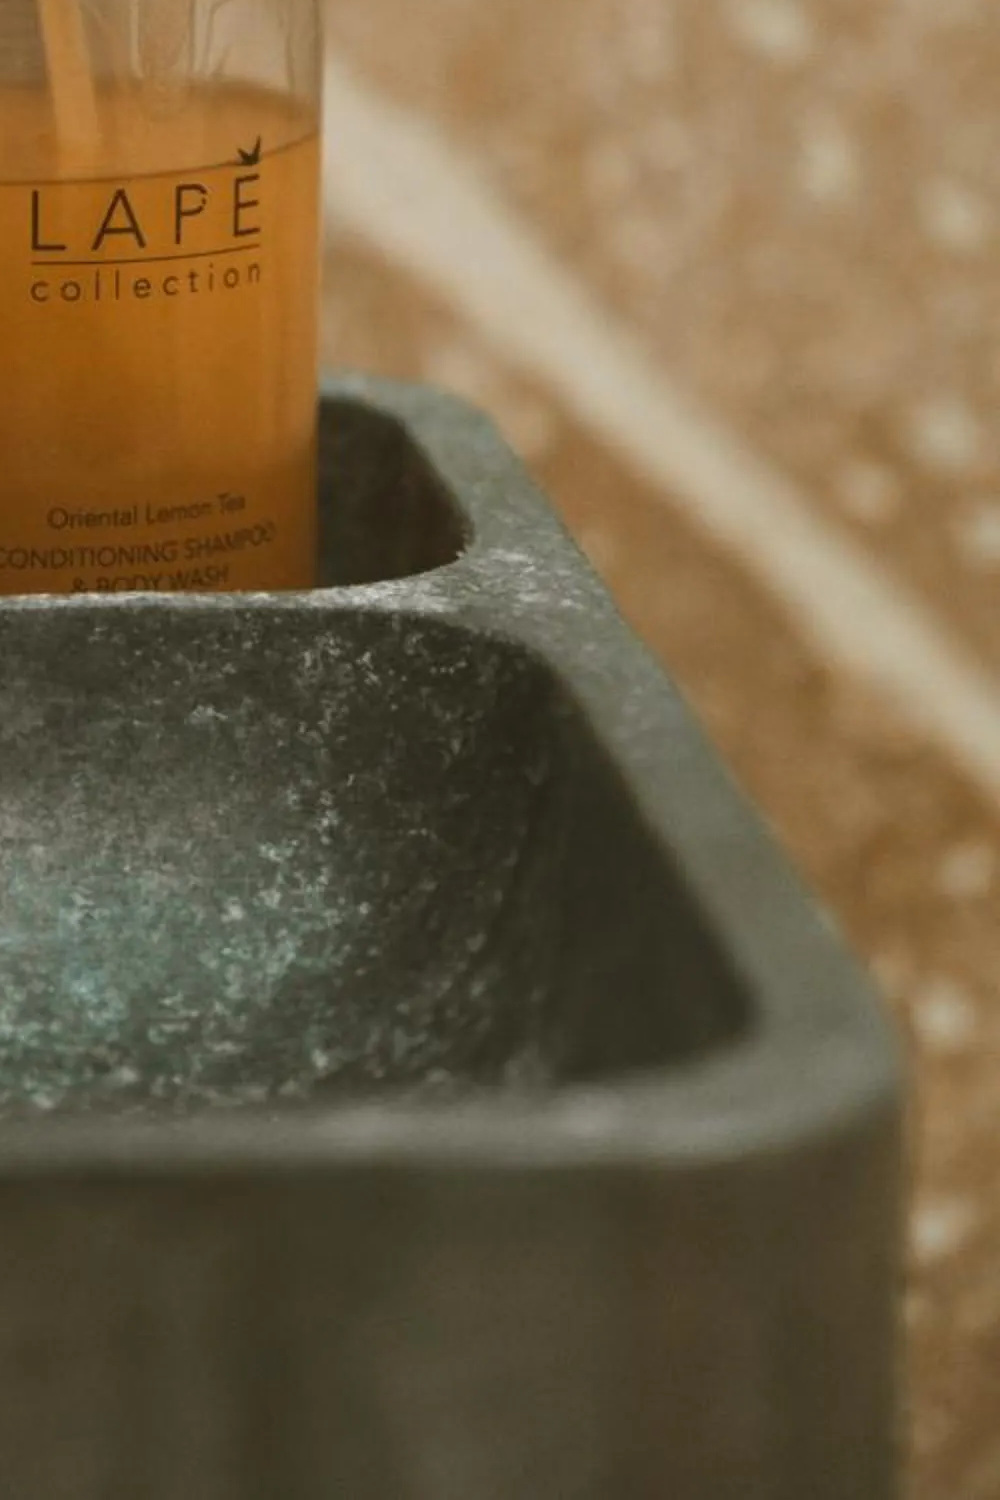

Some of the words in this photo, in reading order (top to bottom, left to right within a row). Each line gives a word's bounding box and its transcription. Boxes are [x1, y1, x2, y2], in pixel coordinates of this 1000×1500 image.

[30, 263, 261, 302] collection
[47, 506, 138, 530] Oriental
[145, 500, 212, 525] Lemon
